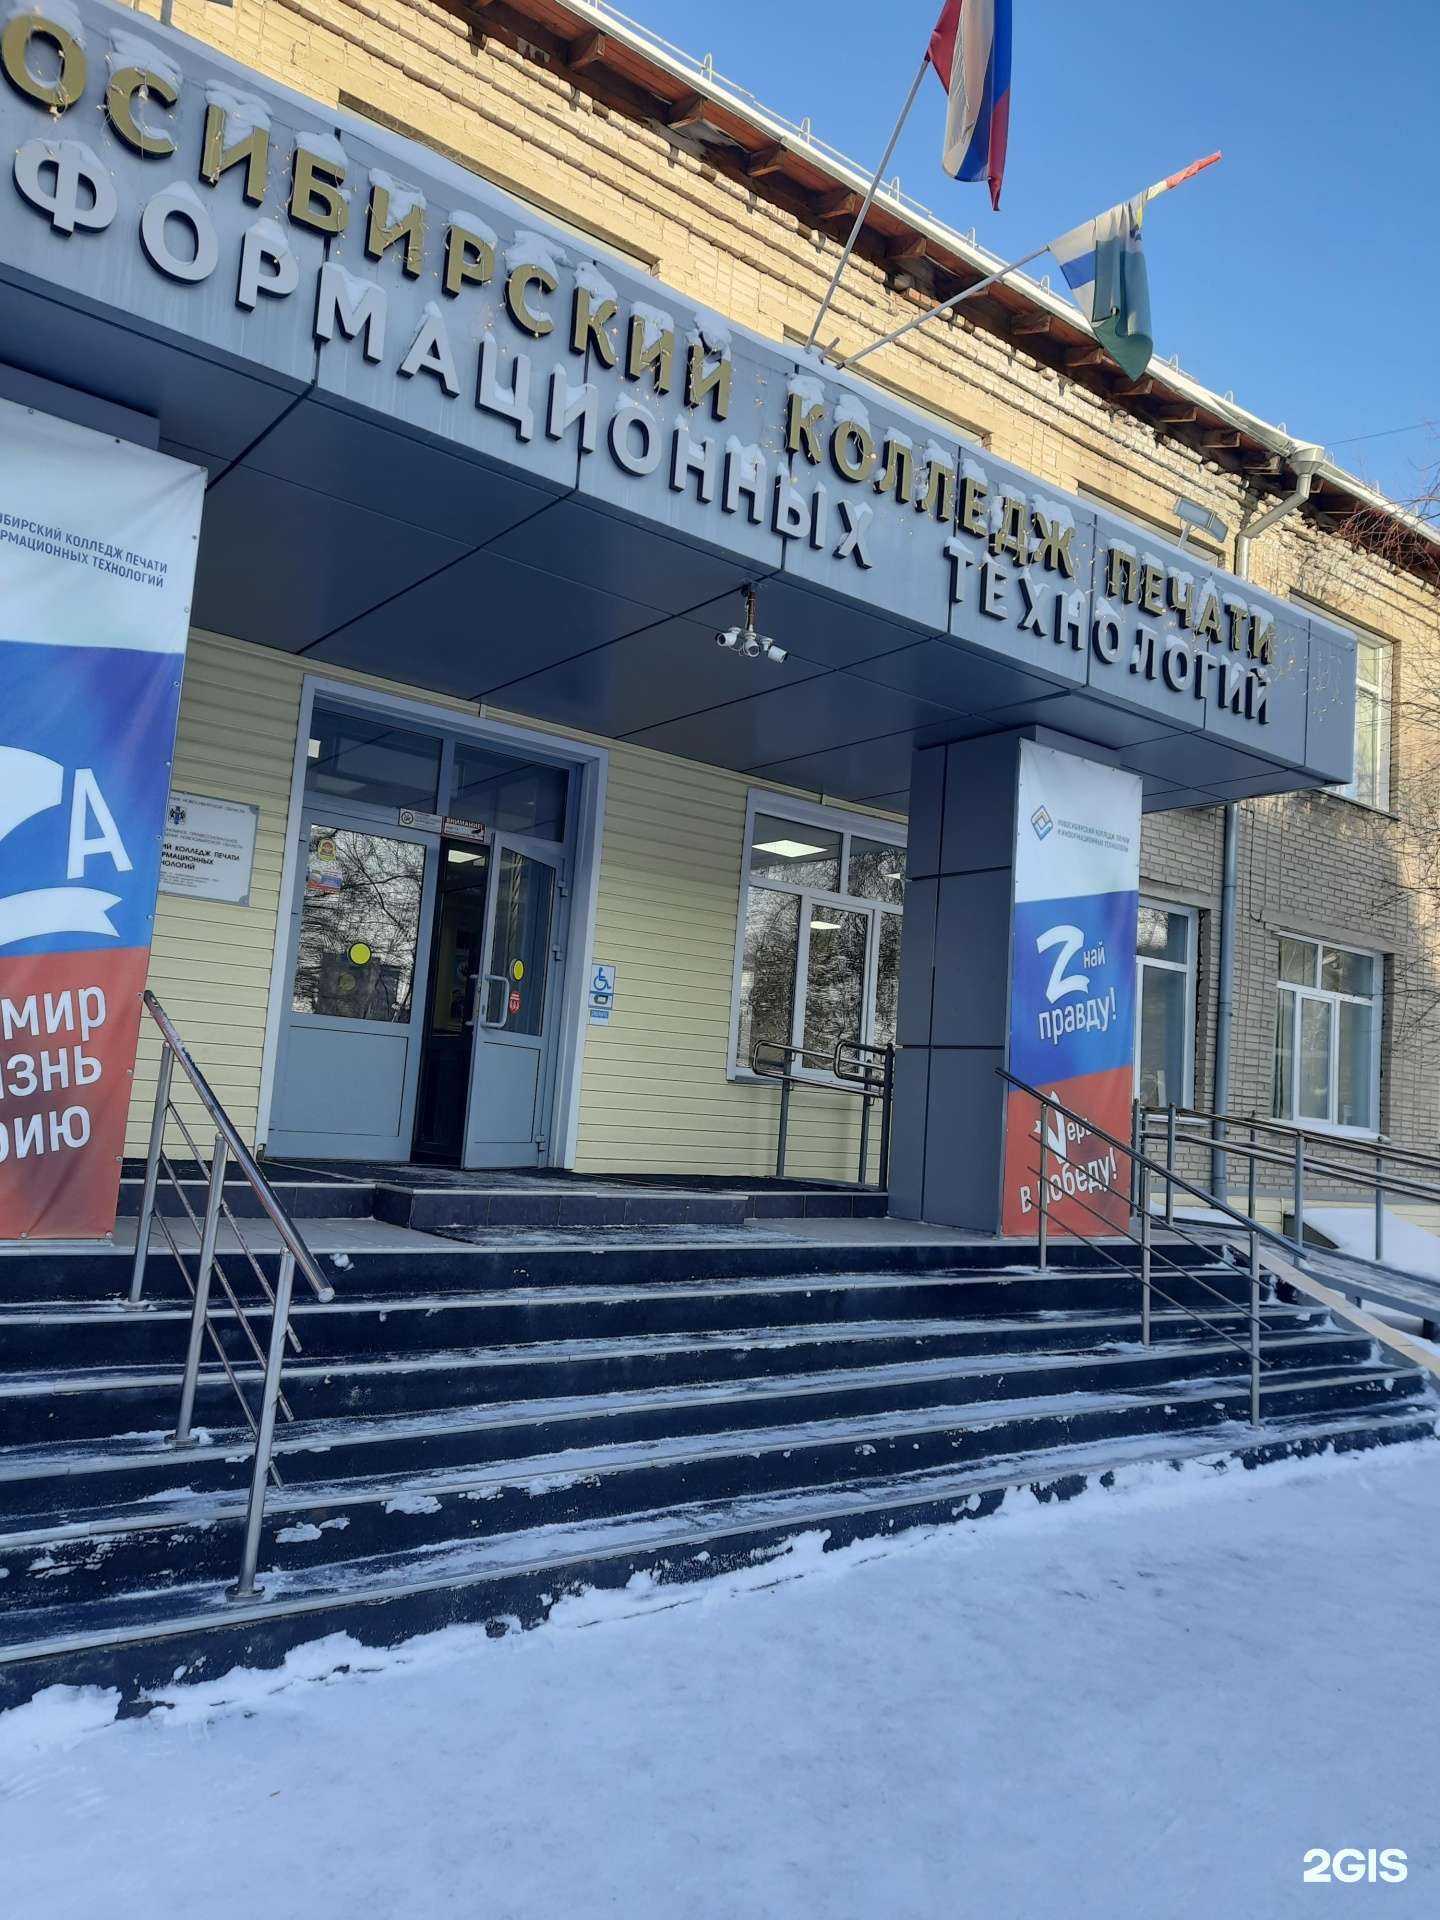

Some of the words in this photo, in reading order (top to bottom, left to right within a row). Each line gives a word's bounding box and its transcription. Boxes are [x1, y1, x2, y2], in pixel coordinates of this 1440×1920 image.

[1, 13, 732, 421] ОСИБИРСКИЙ
[786, 390, 1076, 578] КОЛЛЕДЖ
[1107, 545, 1275, 665] ПЕЧАТИ
[12, 148, 873, 570] ФОРМАЦИОННЫХ
[943, 540, 1272, 725] ТЕХНОЛОГИЙ
[65, 532, 124, 561] КОЛЛЕДЖ
[125, 551, 168, 574] ПЕЧАТИ
[92, 555, 164, 588] ТЕХНОЛОГИЙ
[175, 845, 211, 857] КОЛЛЕДЖ
[214, 851, 240, 861] ПЕЧАТИ
[1, 986, 106, 1042] мир
[1038, 986, 1117, 1045] правду!
[0, 1045, 102, 1099] знь
